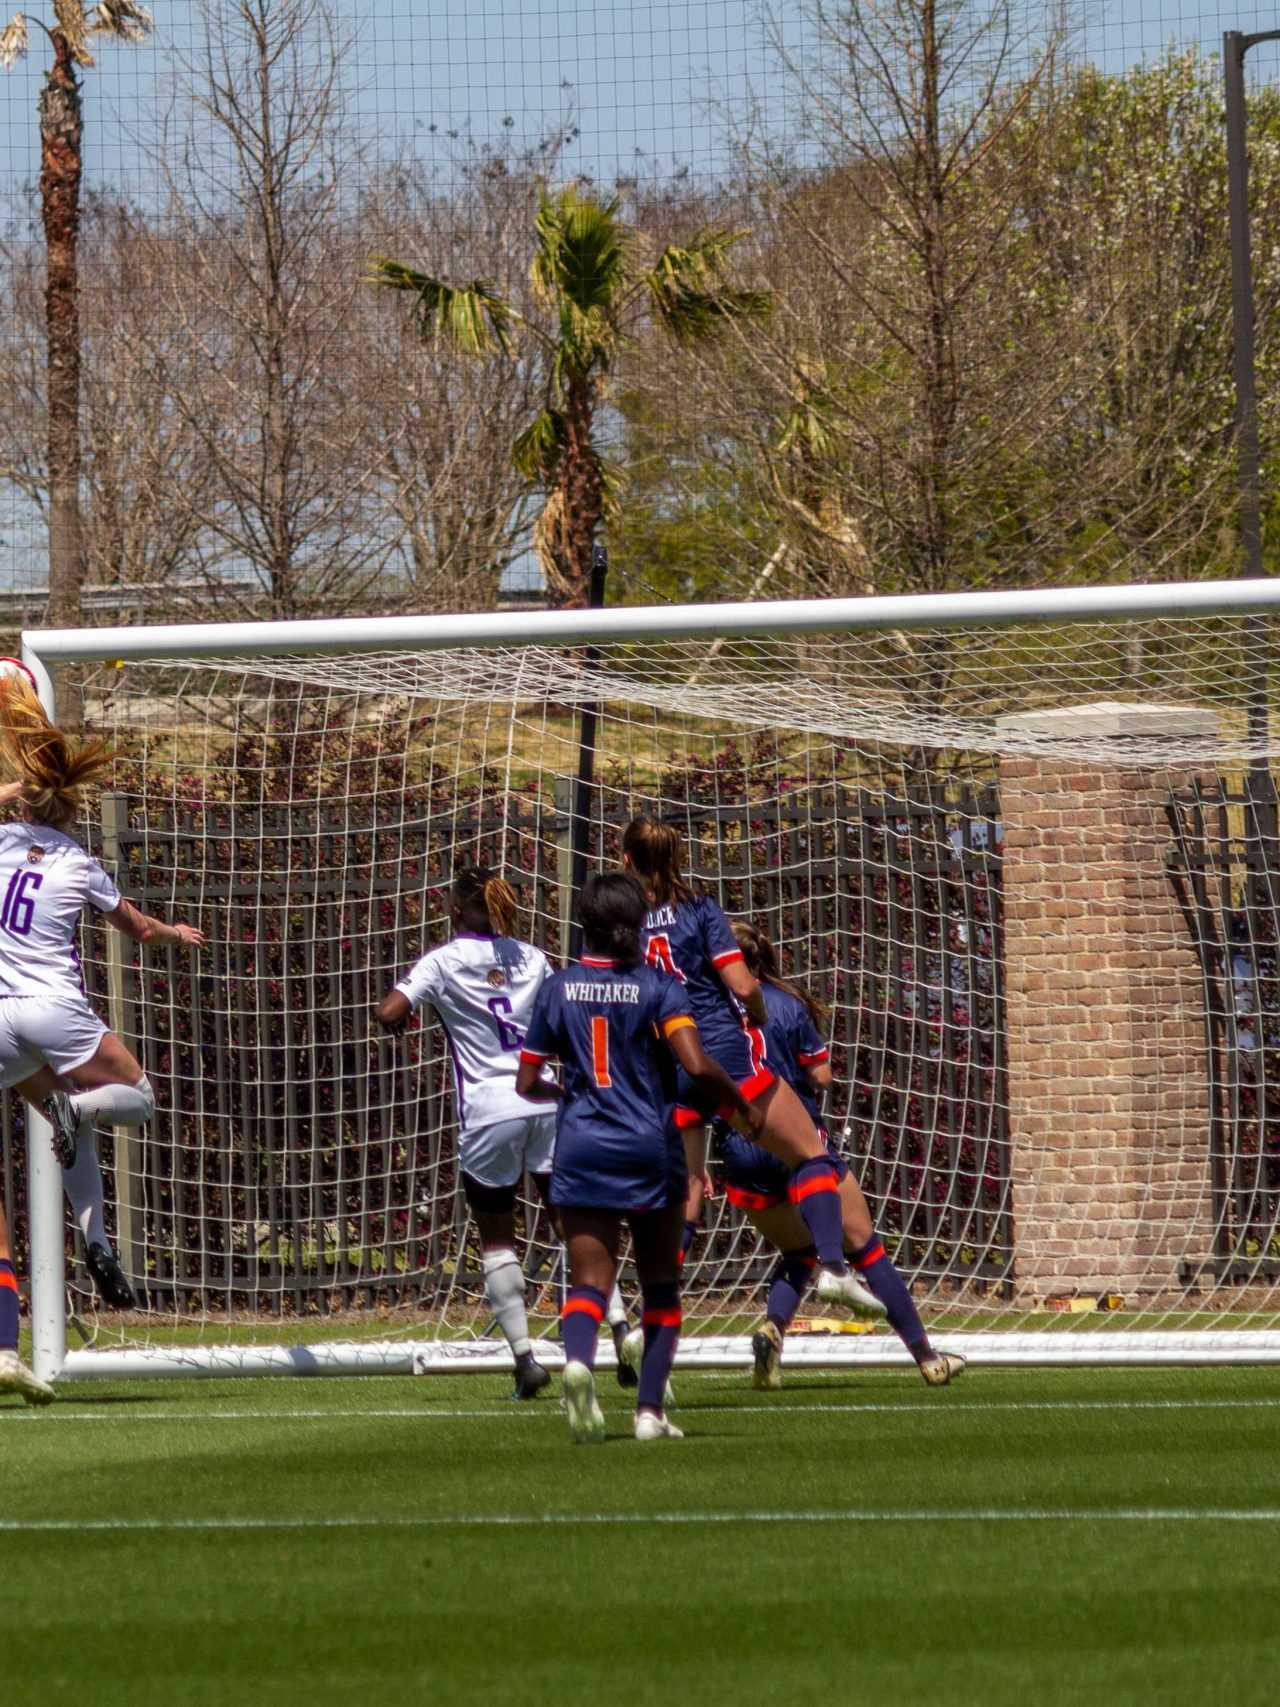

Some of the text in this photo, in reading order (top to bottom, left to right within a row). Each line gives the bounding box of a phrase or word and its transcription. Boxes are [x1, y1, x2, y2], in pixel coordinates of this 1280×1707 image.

[1, 868, 44, 936] 16
[487, 996, 524, 1052] 6
[564, 982, 640, 1004] WHITAKER
[591, 1016, 612, 1088] 1
